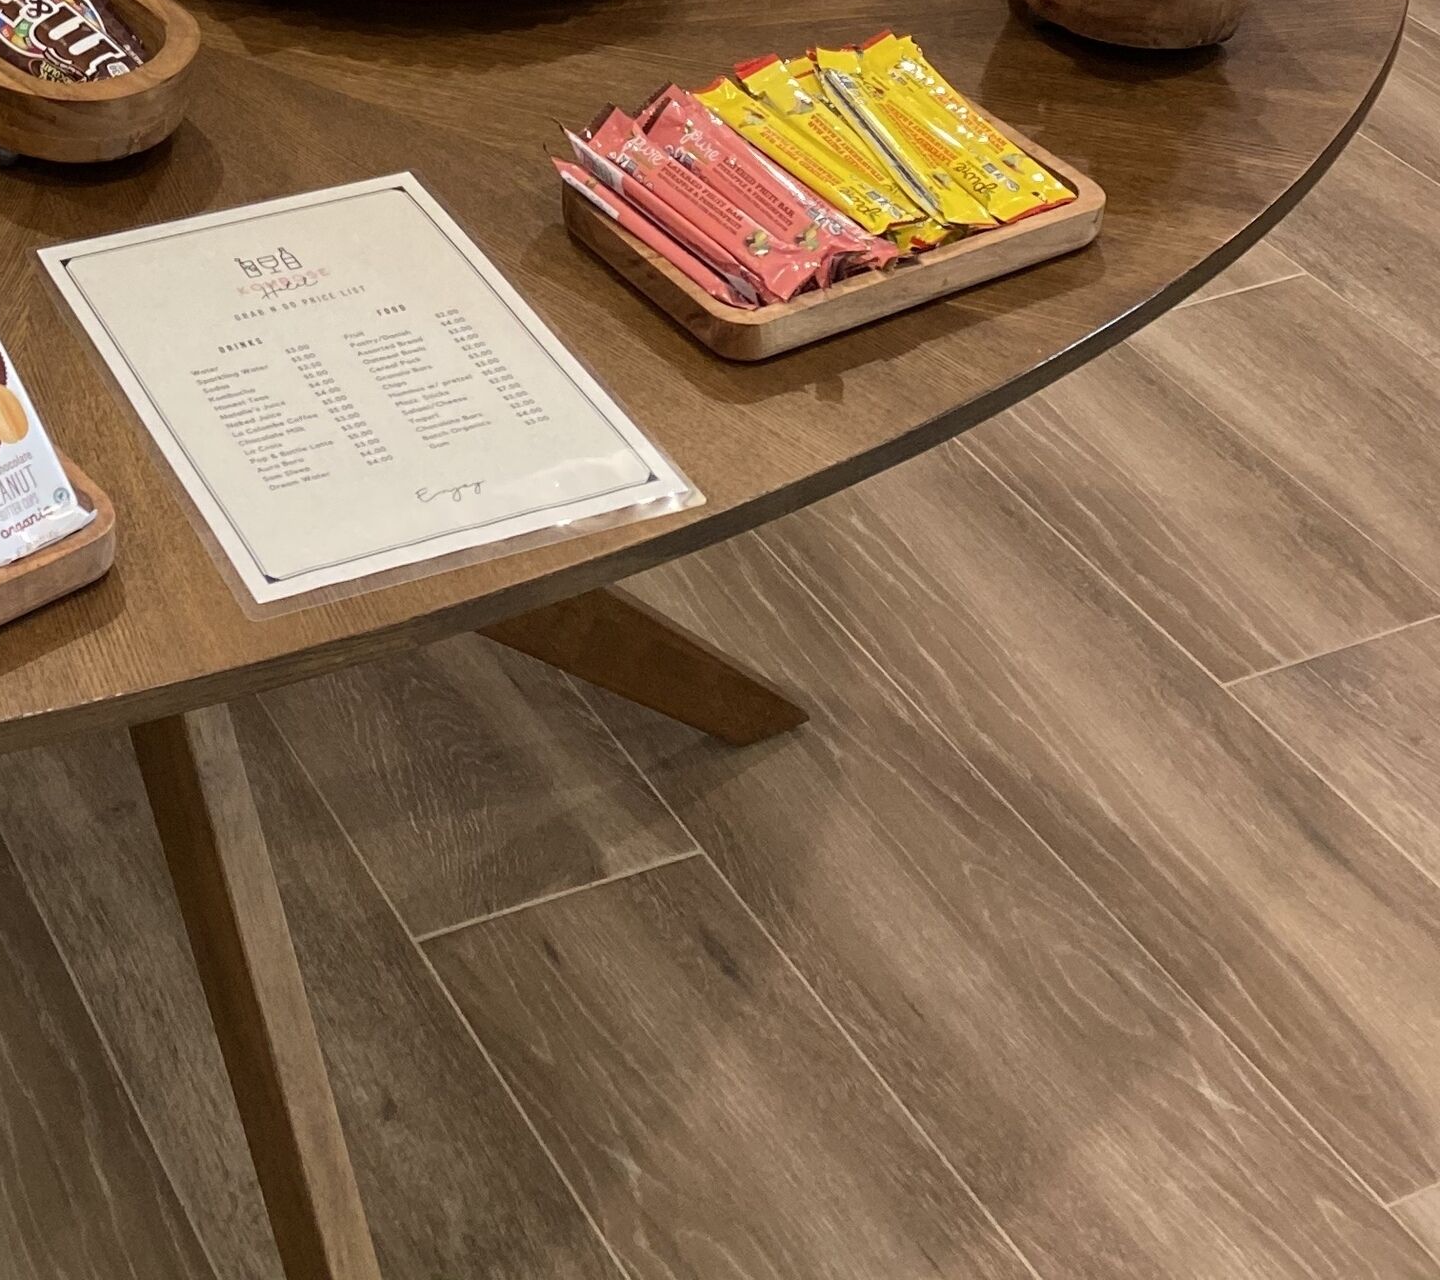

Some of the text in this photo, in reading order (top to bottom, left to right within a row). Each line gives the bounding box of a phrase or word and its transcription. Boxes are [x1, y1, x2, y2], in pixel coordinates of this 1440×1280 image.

[954, 162, 998, 196] pure
[778, 200, 796, 219] BAR
[301, 292, 336, 305] PRICE
[340, 285, 366, 297] LIST
[218, 337, 263, 354] DRINKS
[0, 504, 56, 540] organic
